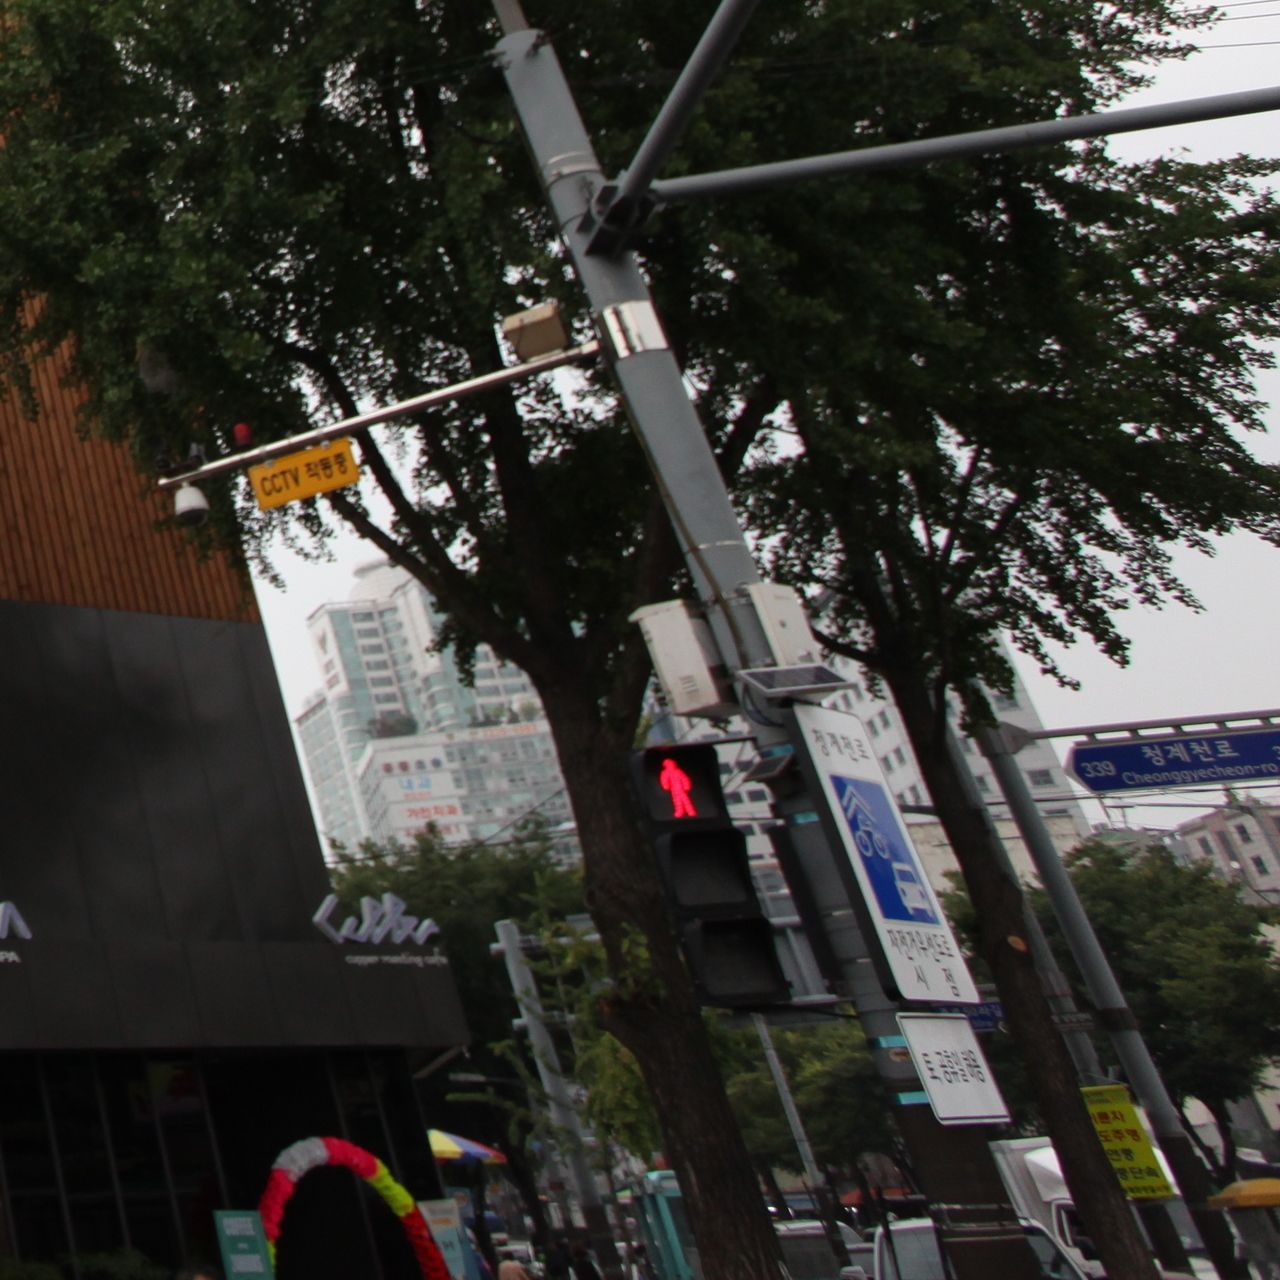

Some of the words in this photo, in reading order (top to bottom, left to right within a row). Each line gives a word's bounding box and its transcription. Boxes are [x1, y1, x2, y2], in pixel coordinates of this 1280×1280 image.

[261, 467, 300, 496] CCTV
[304, 452, 348, 481] 작동중
[812, 728, 870, 762] 청계천로
[1080, 761, 1116, 778] 339
[1141, 739, 1239, 767] 청계천로
[1121, 762, 1279, 785] Cheonggyecheon-ro
